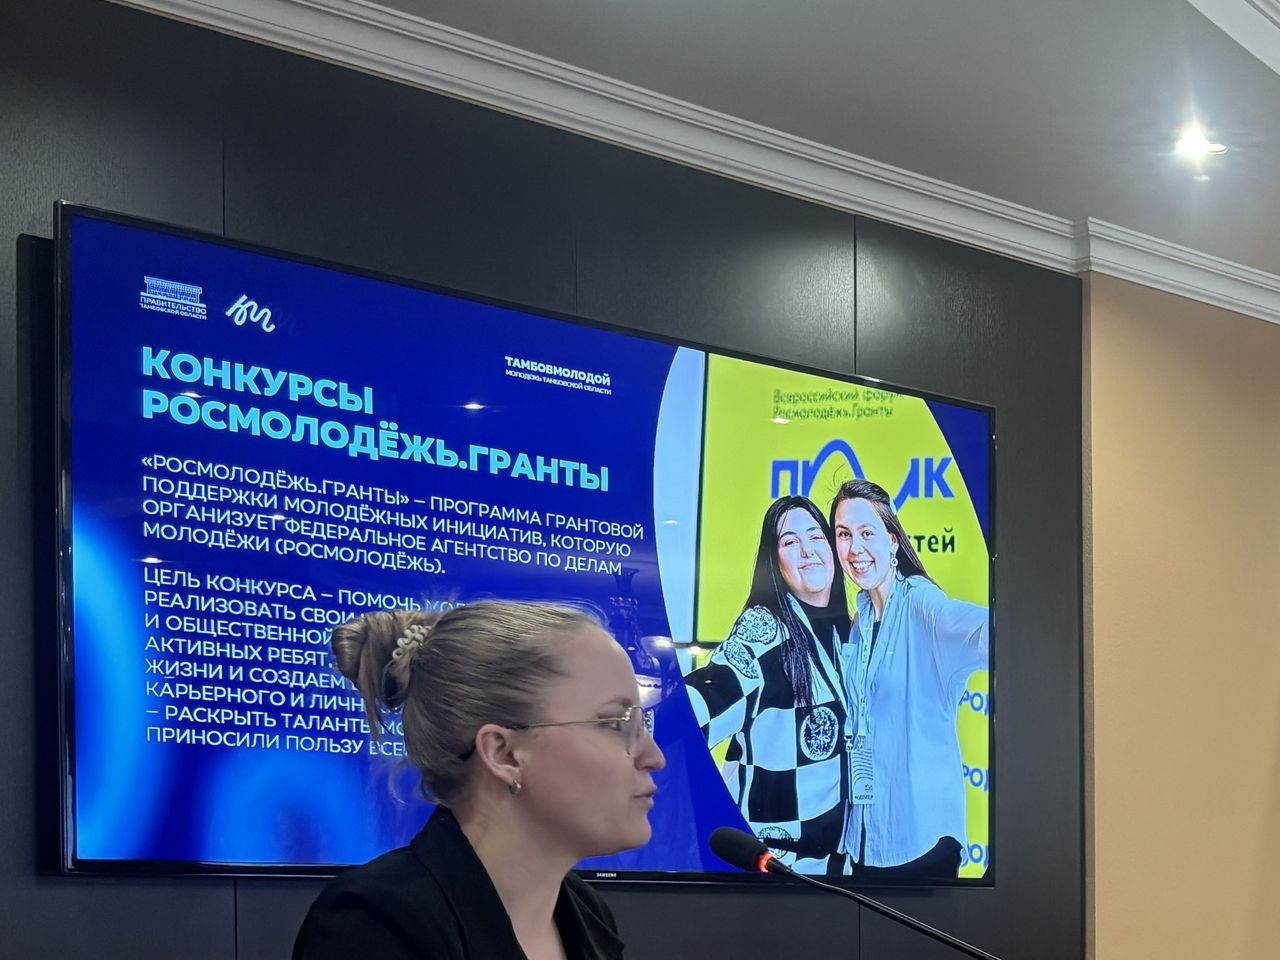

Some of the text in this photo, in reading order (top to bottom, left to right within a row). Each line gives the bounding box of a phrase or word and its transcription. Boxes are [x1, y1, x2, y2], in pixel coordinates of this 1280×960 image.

[140, 296, 207, 315] ПРАВИТЕЛЬСТВО
[141, 346, 374, 415] КОНКУРСЫ
[504, 355, 611, 386] ТАМБОВМОЛОДОЙ
[142, 389, 610, 493] РОСМОЛОДЁЖЬ.ГРАНТЫ
[141, 454, 410, 506] «РОСМОЛОДЁЖЬ.ГРАНТЫ»
[430, 495, 542, 526] ПРОГРАММА
[546, 512, 644, 541] ГРАНТОВОЙ
[142, 475, 631, 558] ПОДДЕРЖКИ МОЛОДЁЖНЫХ ИНИЦИАТИВ, КОТОРУЮ
[142, 499, 622, 577] ОРГАНИЗУЕТ ФЕДЕРАЛЬНОЕ АГЕНТСТВО ПО ДЕЛАМ
[143, 520, 447, 575] МОЛОДЁЖИ (РОСМОЛОДЁЖЬ).
[144, 566, 201, 588] ЦЕЛЬ
[206, 573, 317, 601] КОНКУРСА
[337, 588, 421, 612] ПОМОЧЬ
[144, 589, 297, 621] РЕАЛИЗОВАТЬ
[145, 612, 333, 646] И ОБЩЕСТВЕННОЙ
[144, 635, 334, 669] АКТИВНЫХ РЕБЯТ.
[145, 658, 347, 690] ЖИЗНИ И СОЗДАЕМ
[146, 680, 366, 713] КАРЬЕРНОГО И ЛИЧН
[164, 704, 277, 728] РАСКРЫТЬ
[146, 726, 280, 750] ПРИНОСИЛИ
[286, 735, 364, 755] ПОЛЬЗУ
